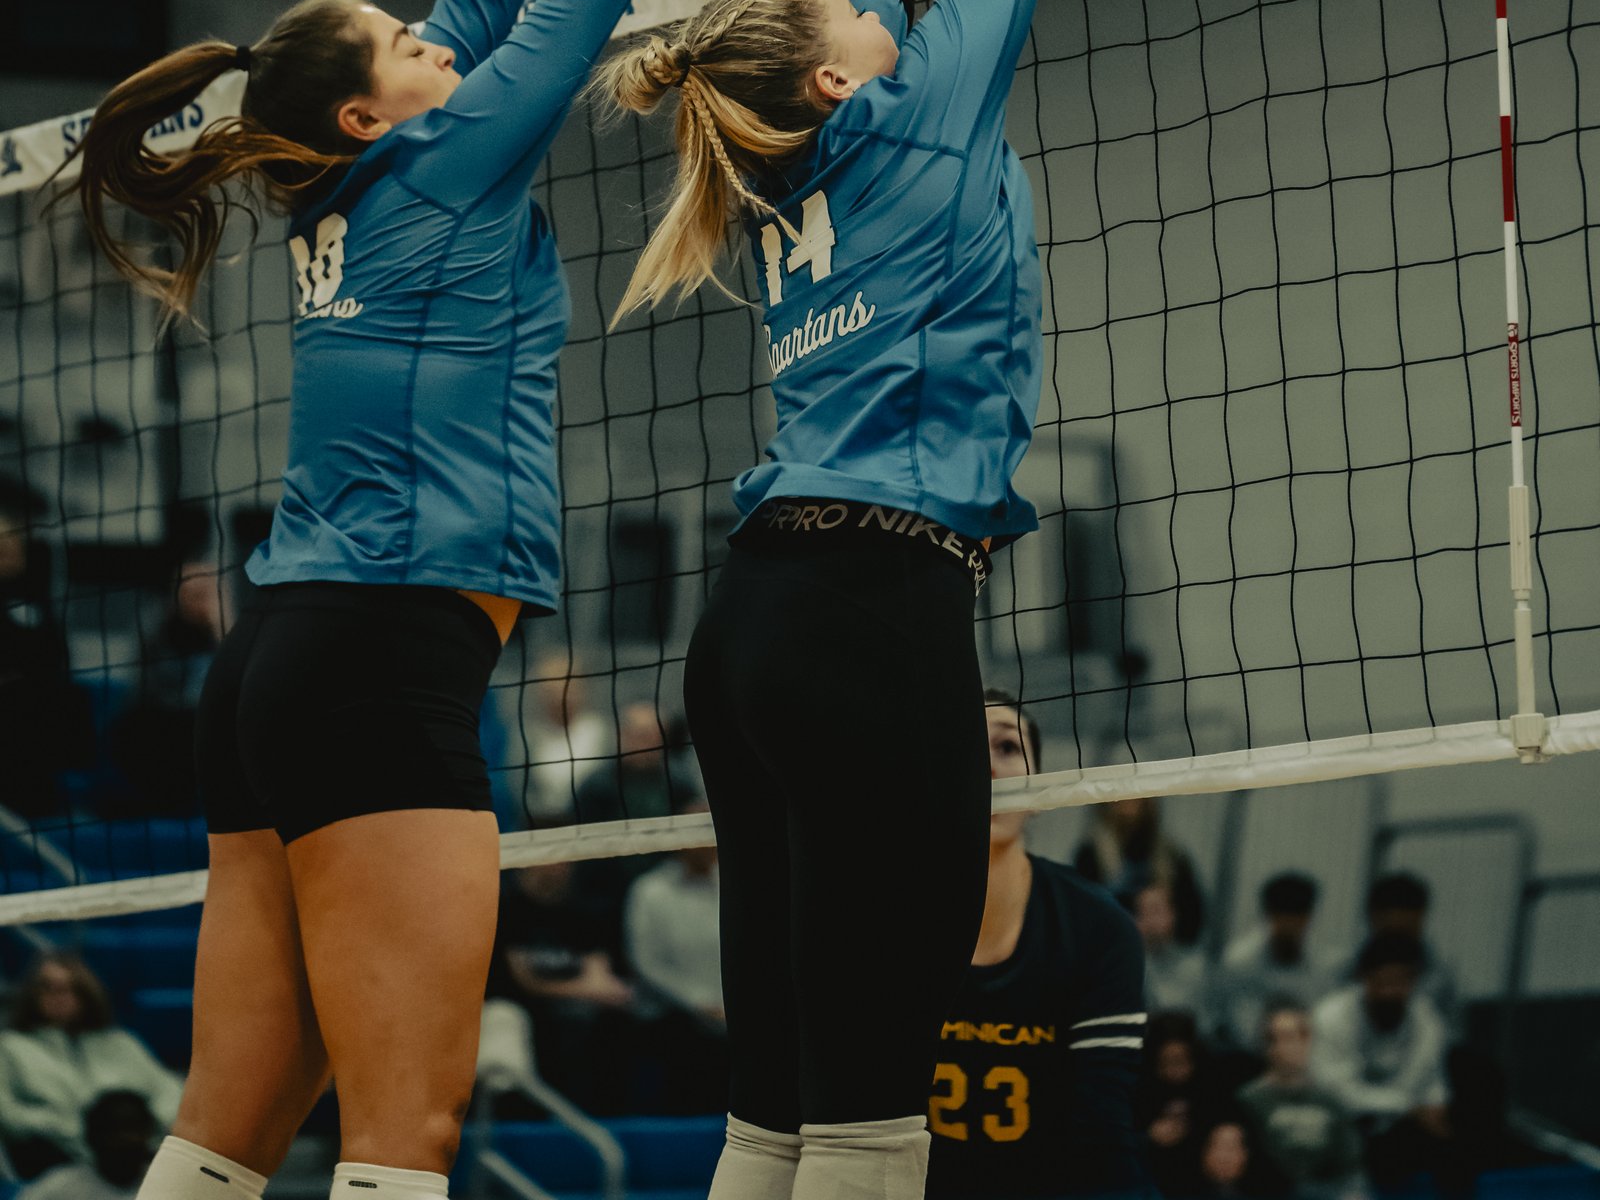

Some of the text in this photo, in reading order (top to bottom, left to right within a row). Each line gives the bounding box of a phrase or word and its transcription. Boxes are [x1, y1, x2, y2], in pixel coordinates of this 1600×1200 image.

[760, 189, 836, 308] 14
[1508, 341, 1519, 380] SPORTS
[1511, 380, 1521, 424] IMPORTS
[857, 504, 965, 559] NIKE
[928, 1062, 1031, 1142] 23
